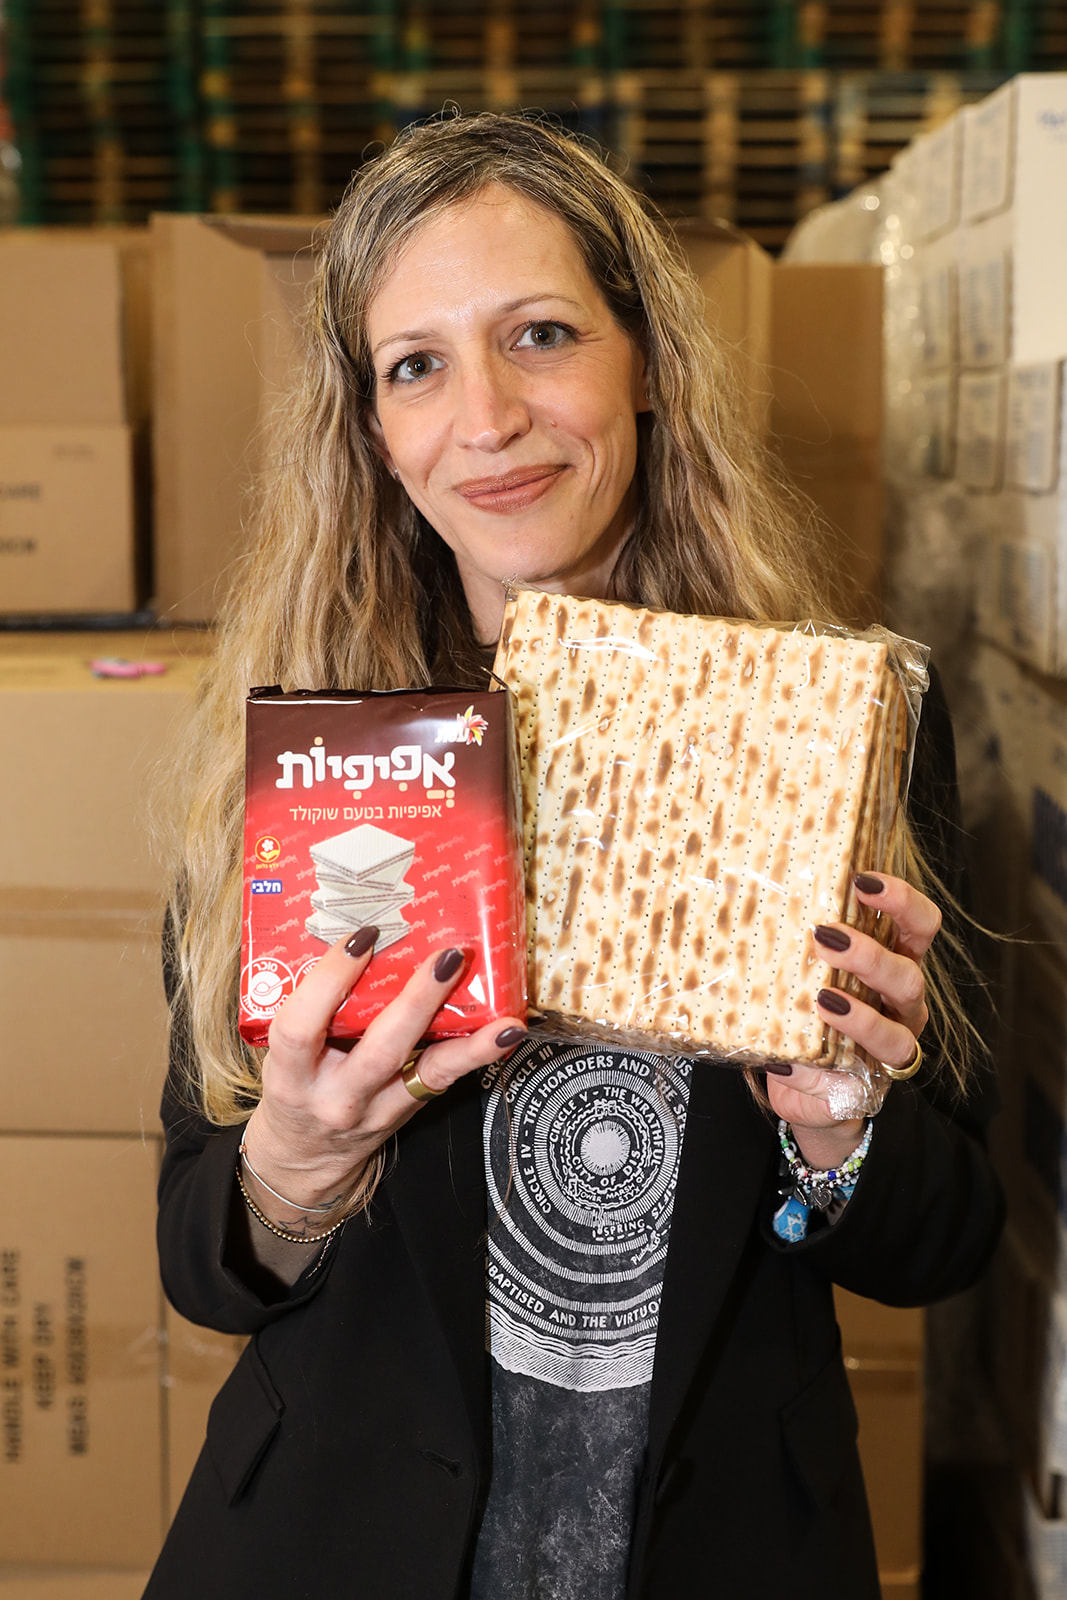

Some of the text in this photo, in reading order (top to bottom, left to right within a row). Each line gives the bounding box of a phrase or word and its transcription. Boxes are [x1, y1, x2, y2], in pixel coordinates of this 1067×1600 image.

[289, 805, 443, 823] אפיפיות בטעם שוקולד
[252, 880, 281, 893] חלבי
[253, 961, 278, 973] סוכר
[480, 1059, 501, 1090] CIR
[505, 1045, 554, 1104] CIRCLE III
[540, 1055, 614, 1098] HOARDERS
[619, 1057, 650, 1077] AND
[652, 1073, 678, 1102] THE
[523, 1096, 542, 1124] THE
[550, 1100, 578, 1143] CIRCLE
[579, 1091, 588, 1102] V
[603, 1086, 627, 1101] THE
[631, 1094, 664, 1167] WRATHFUL
[520, 1143, 532, 1159] IV
[572, 1150, 641, 1187] CITY OF DIS
[524, 1165, 552, 1214] CIRCLE
[605, 1171, 645, 1200] MARSH OF
[619, 1188, 641, 1204] STYX
[603, 1219, 646, 1237] SPRING
[488, 1262, 662, 1328] BAPTISED AND THE VIRTUO
